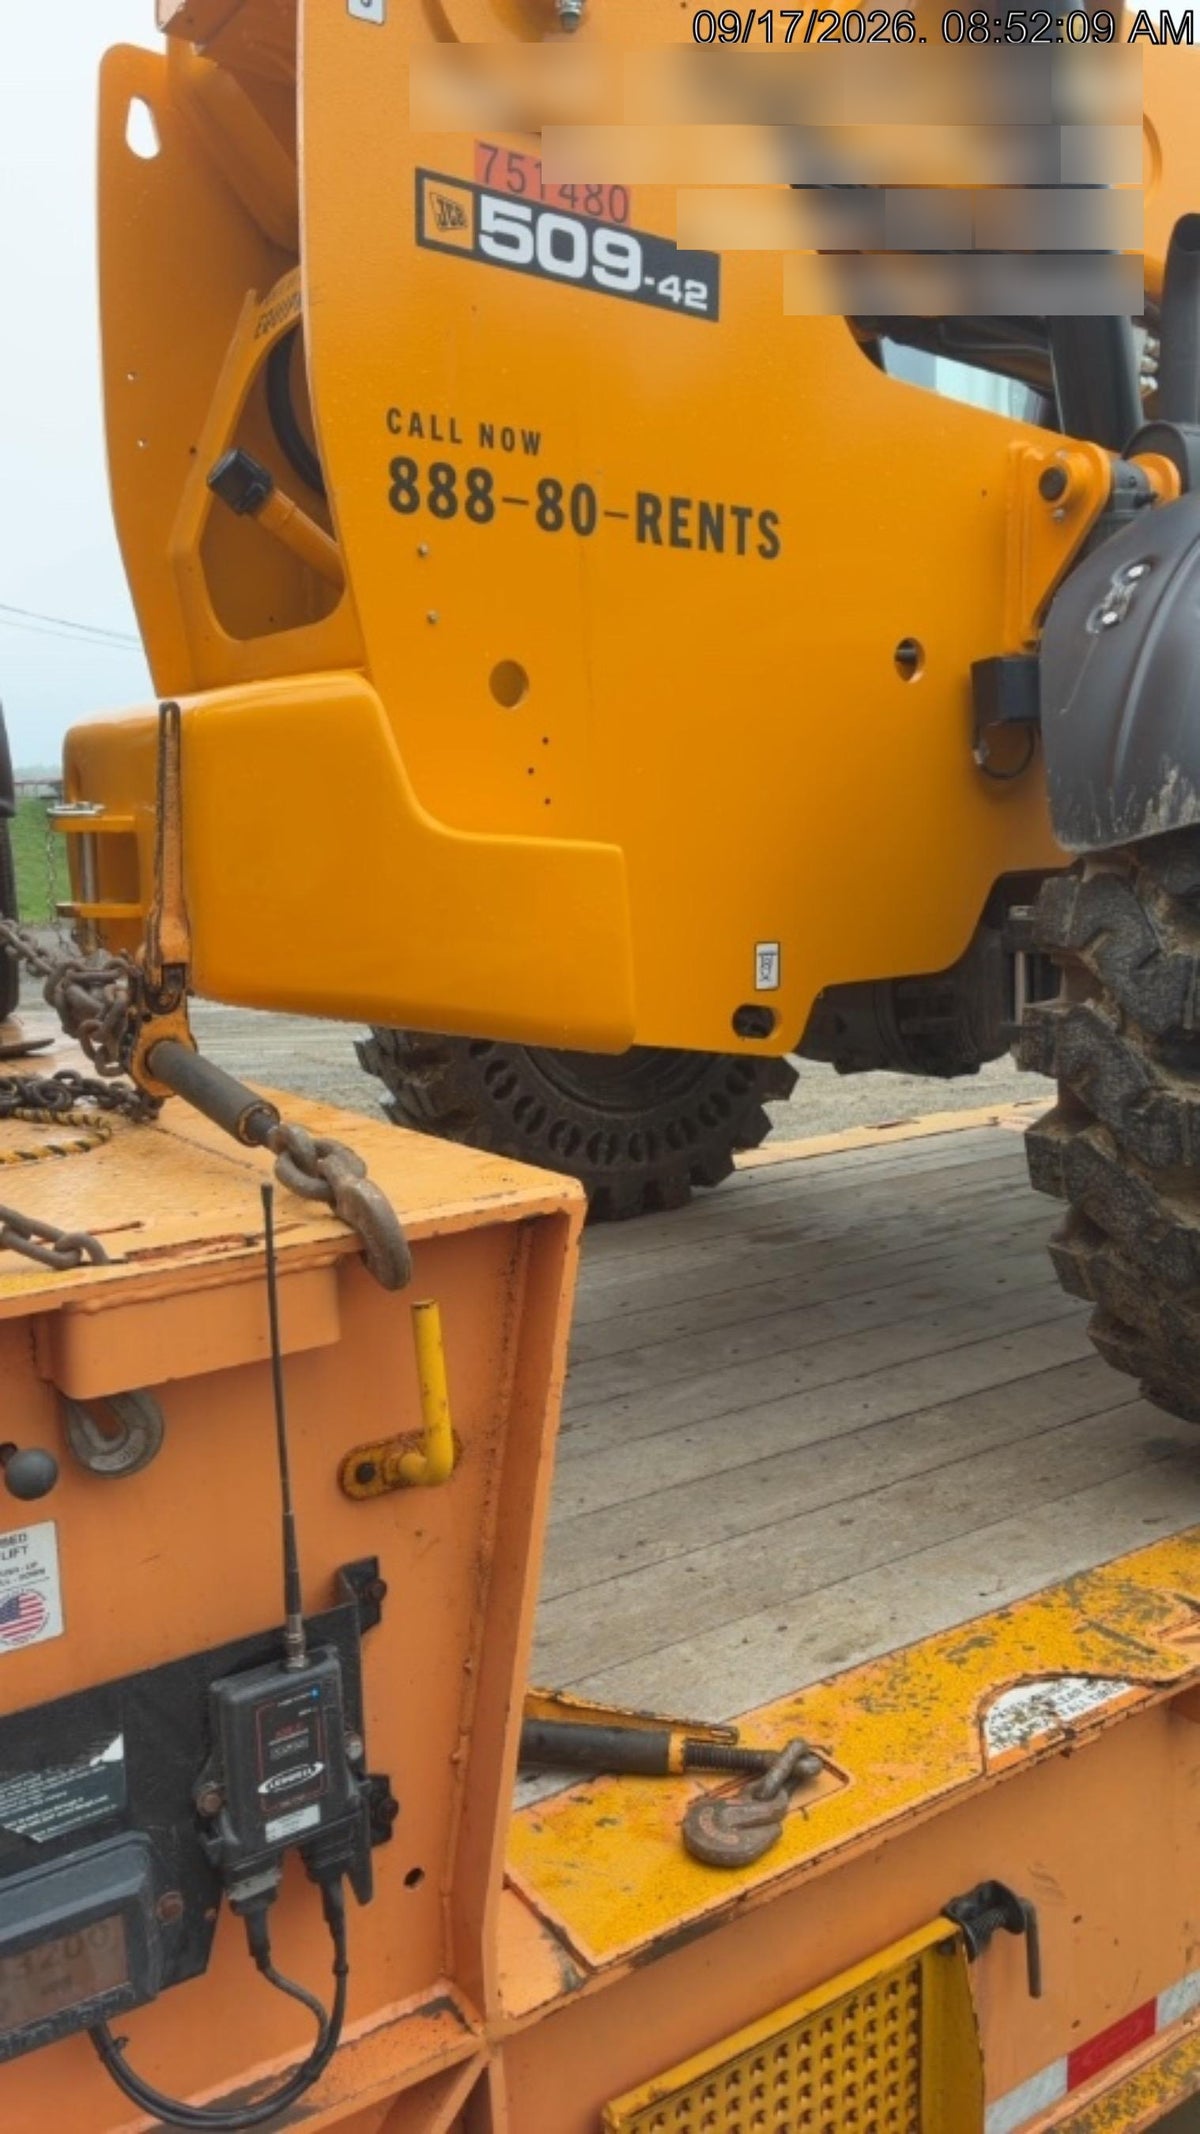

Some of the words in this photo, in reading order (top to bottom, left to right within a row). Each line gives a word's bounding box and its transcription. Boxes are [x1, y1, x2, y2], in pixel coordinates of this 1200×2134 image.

[386, 407, 462, 445] CALL
[479, 422, 542, 456] NOW
[387, 455, 782, 561] 888-80-RENTS
